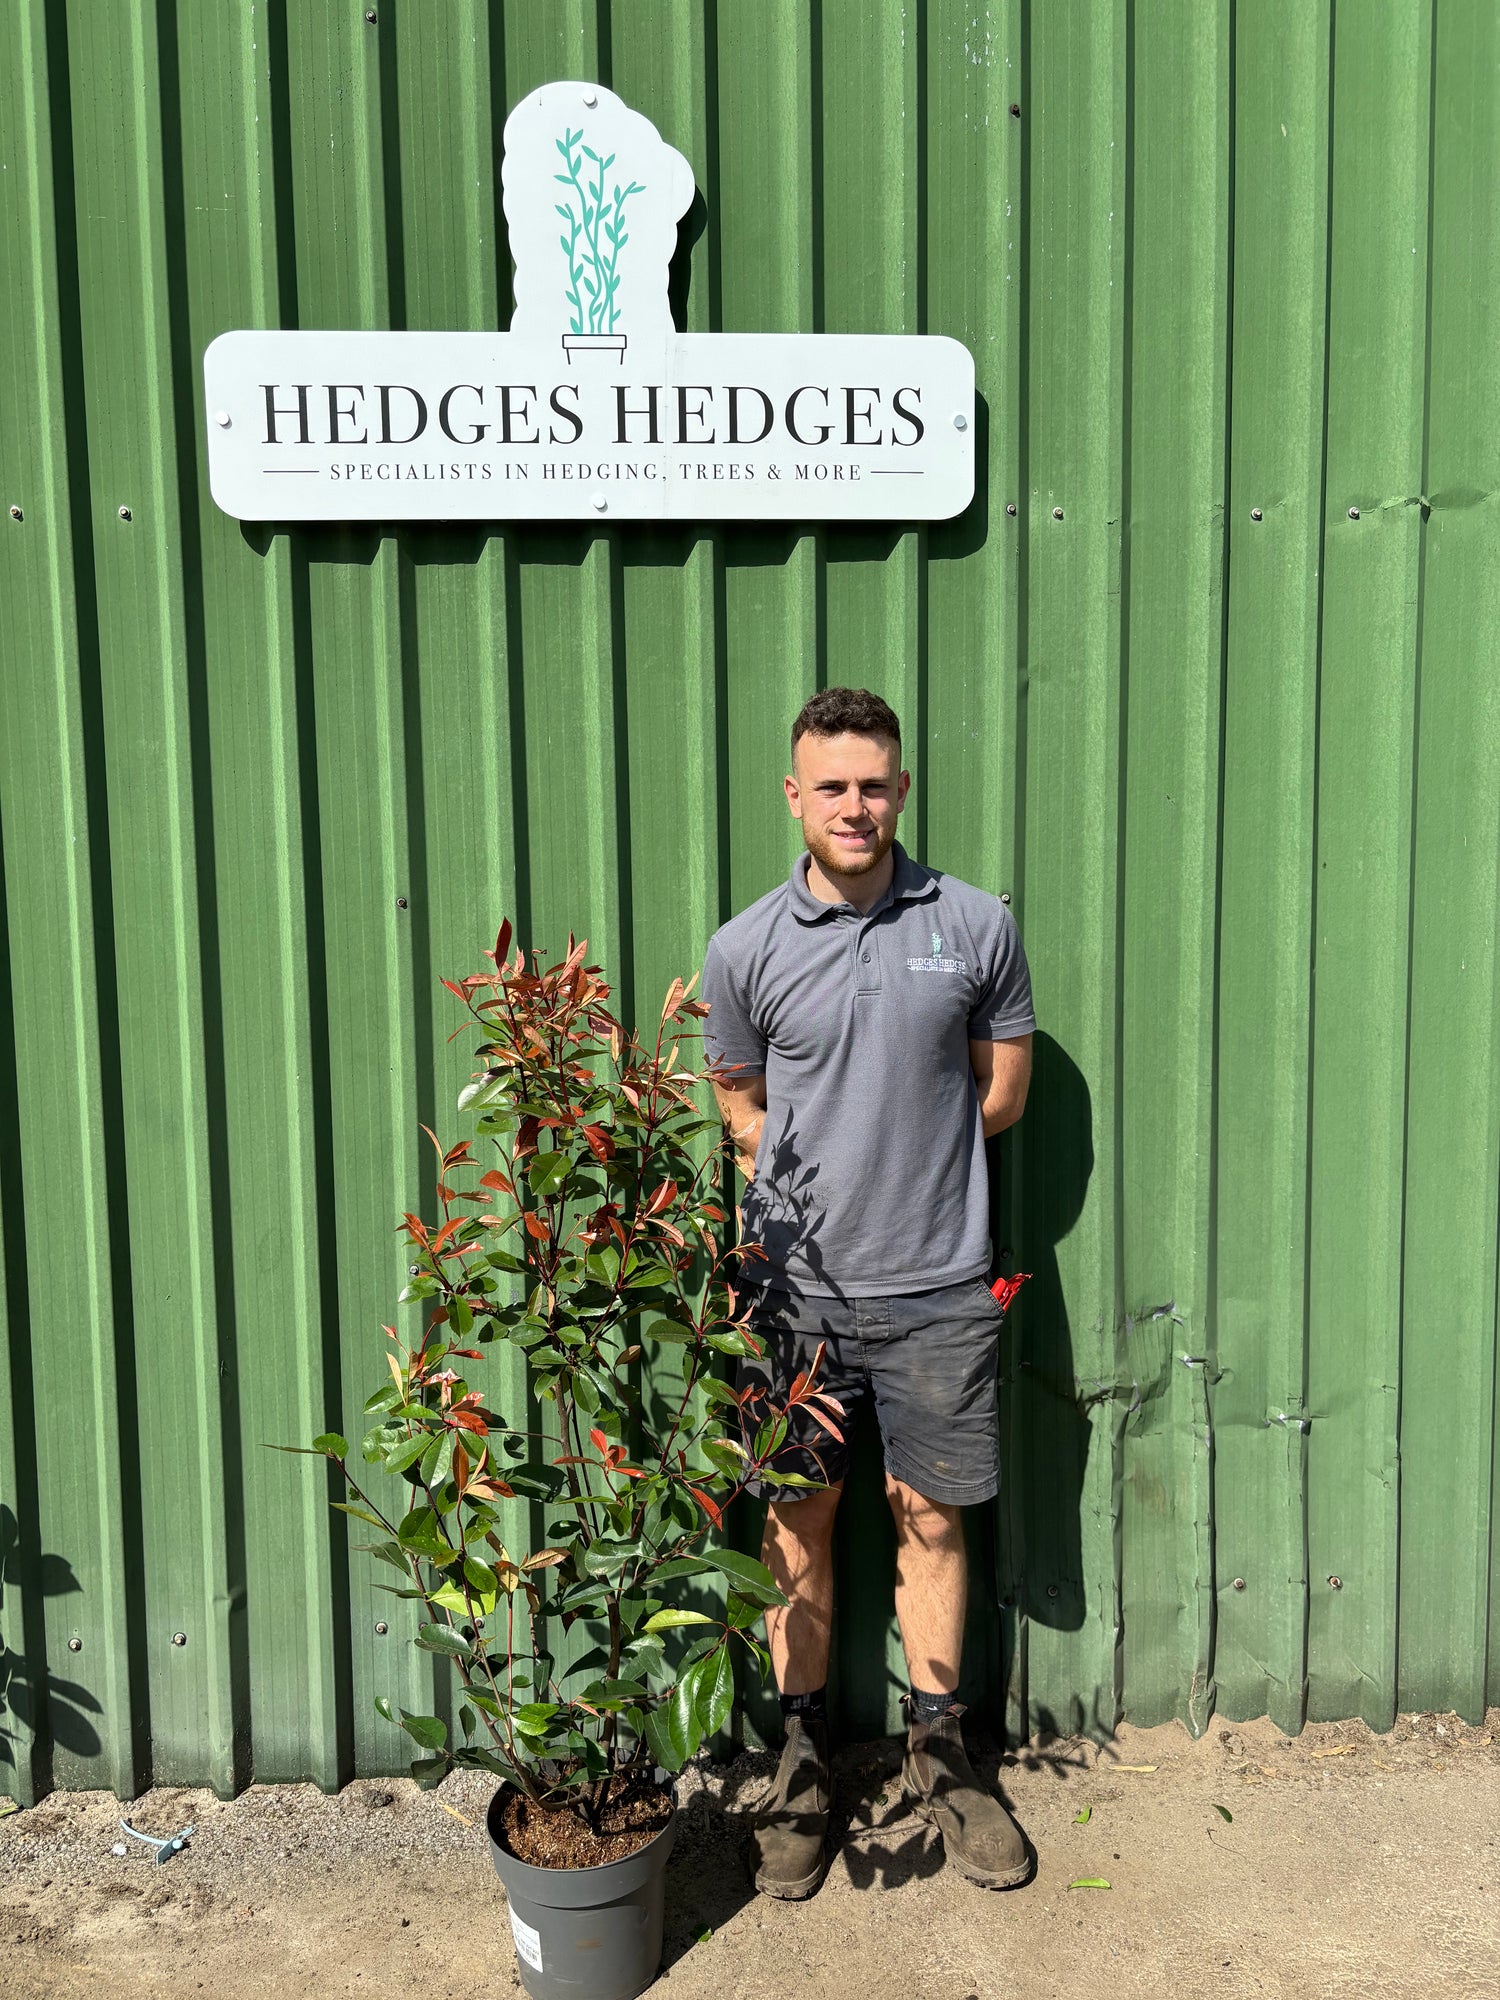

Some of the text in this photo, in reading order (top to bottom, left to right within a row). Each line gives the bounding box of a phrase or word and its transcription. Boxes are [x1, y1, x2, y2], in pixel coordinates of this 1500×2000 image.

[258, 384, 925, 446] HEDGES HEDGES
[330, 463, 863, 482] SPECIALISTS IN HEDGING, TREES & MORE
[907, 957, 938, 966] HEDGES
